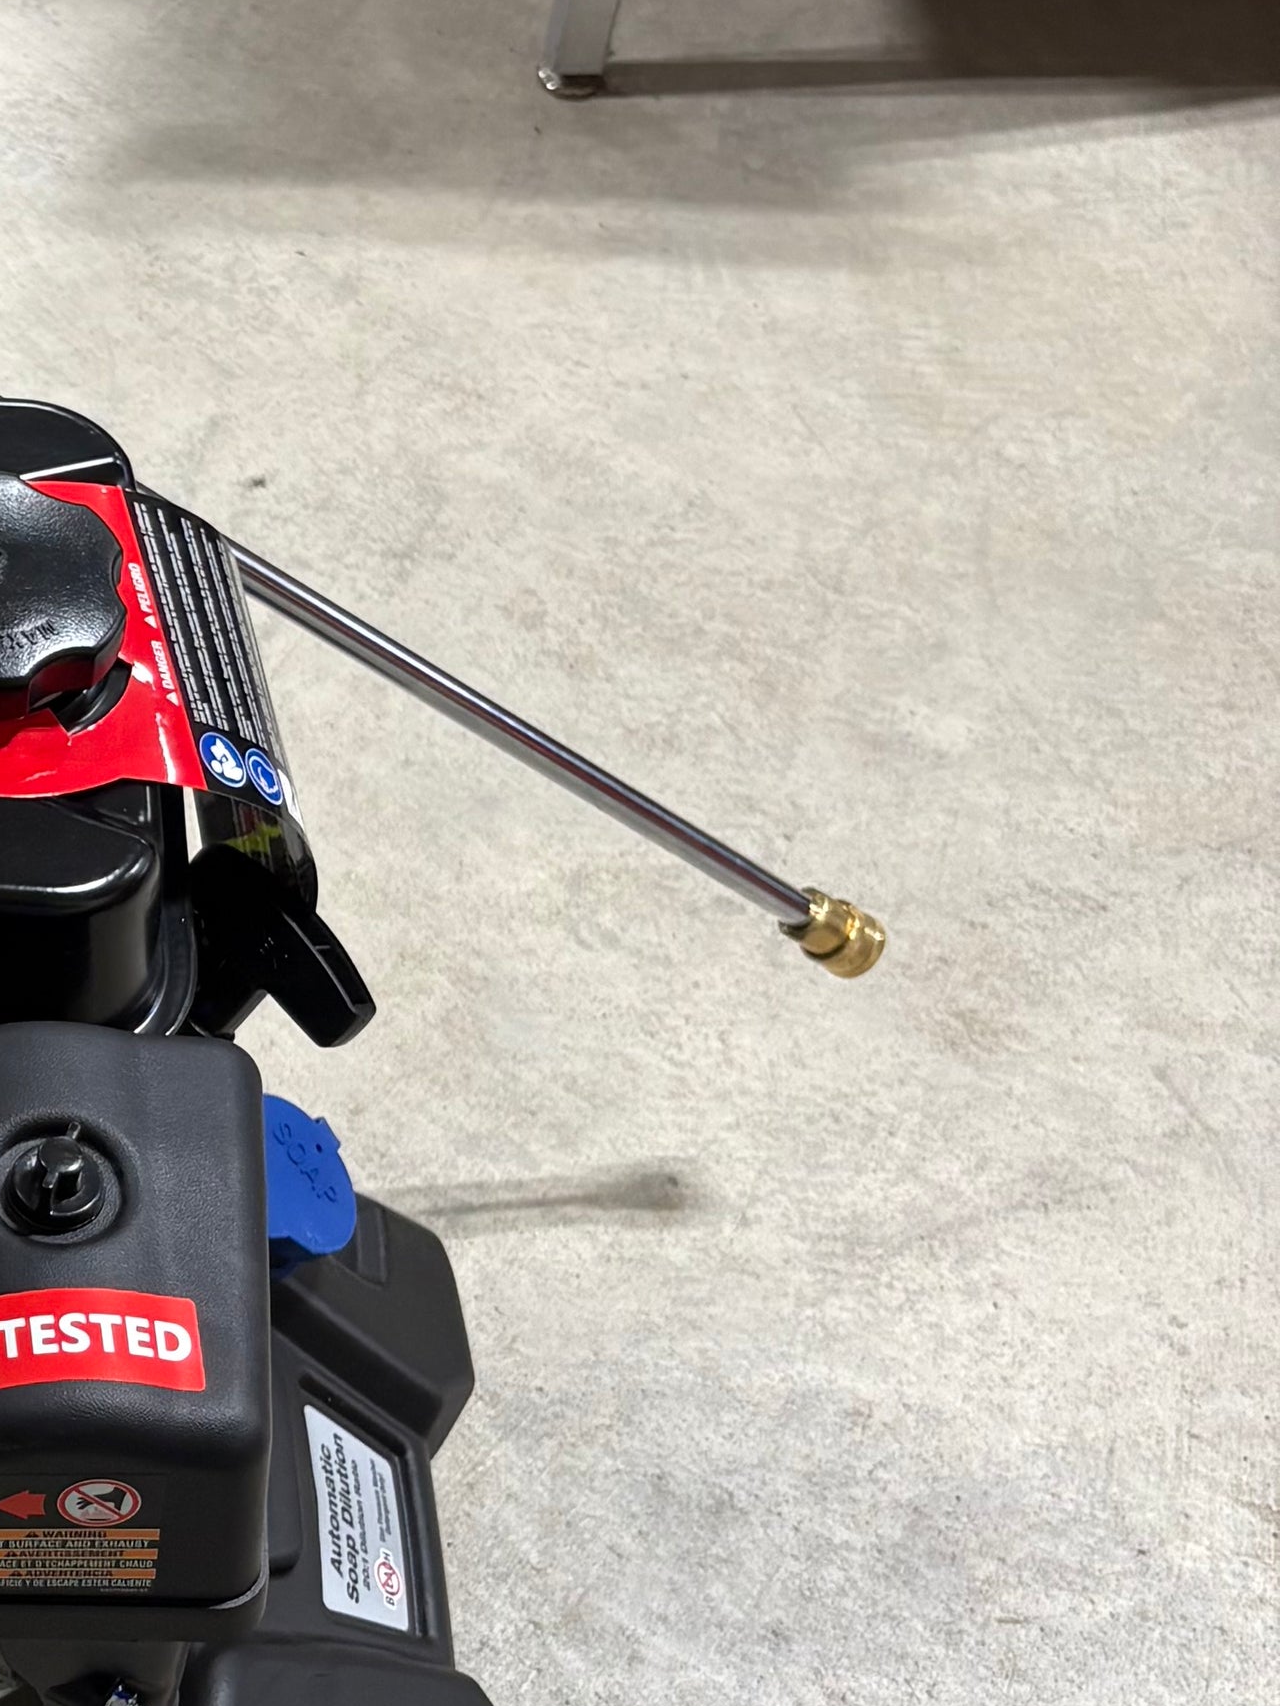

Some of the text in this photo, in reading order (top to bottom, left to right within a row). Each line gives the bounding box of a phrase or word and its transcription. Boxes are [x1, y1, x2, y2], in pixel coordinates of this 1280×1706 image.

[128, 562, 153, 612] PELIGRO
[151, 640, 176, 691] DANGER
[271, 1120, 339, 1206] SOAP
[42, 1530, 107, 1538] WARNING
[319, 1443, 343, 1579] Automatic
[333, 1433, 360, 1604] Soap Dilution
[9, 1540, 63, 1548] SURFACE
[65, 1540, 92, 1548] AND
